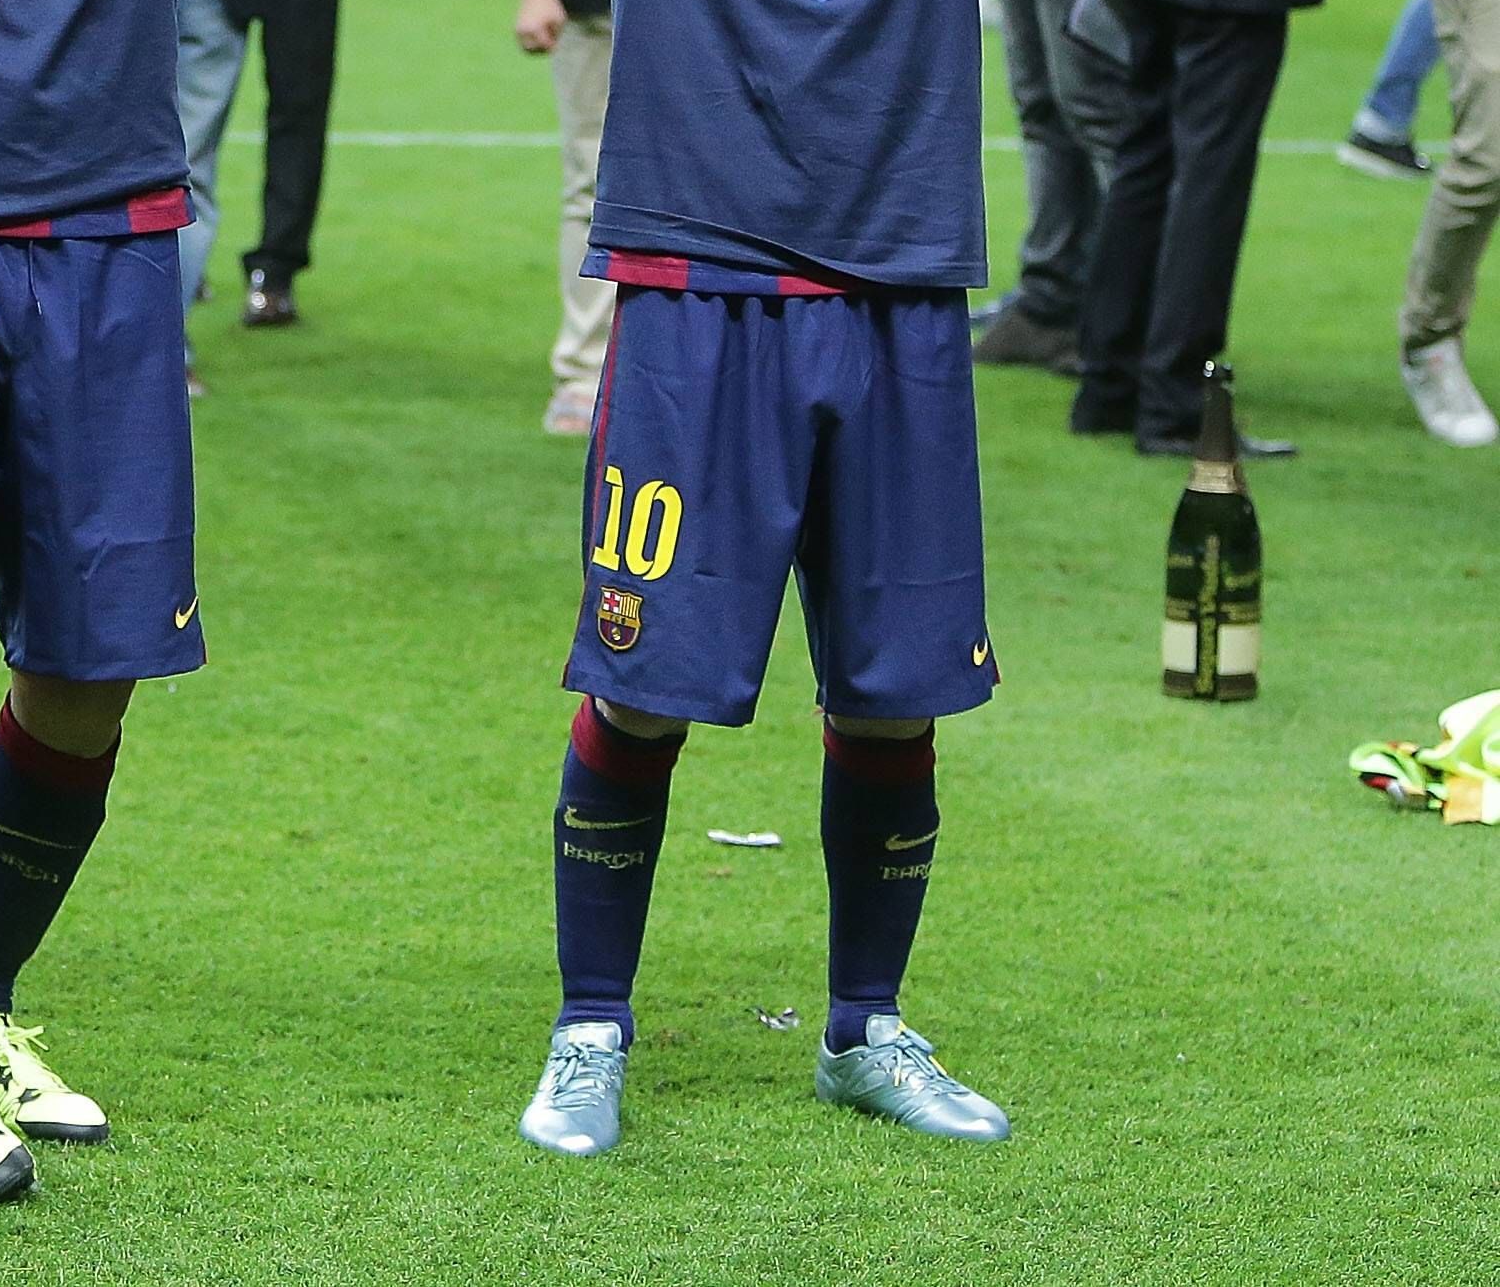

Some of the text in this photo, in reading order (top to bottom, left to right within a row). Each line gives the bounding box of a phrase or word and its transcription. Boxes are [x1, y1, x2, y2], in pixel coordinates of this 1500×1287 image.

[591, 464, 684, 582] 10
[563, 841, 645, 870] BARÇA
[883, 861, 931, 881] BARÇ
